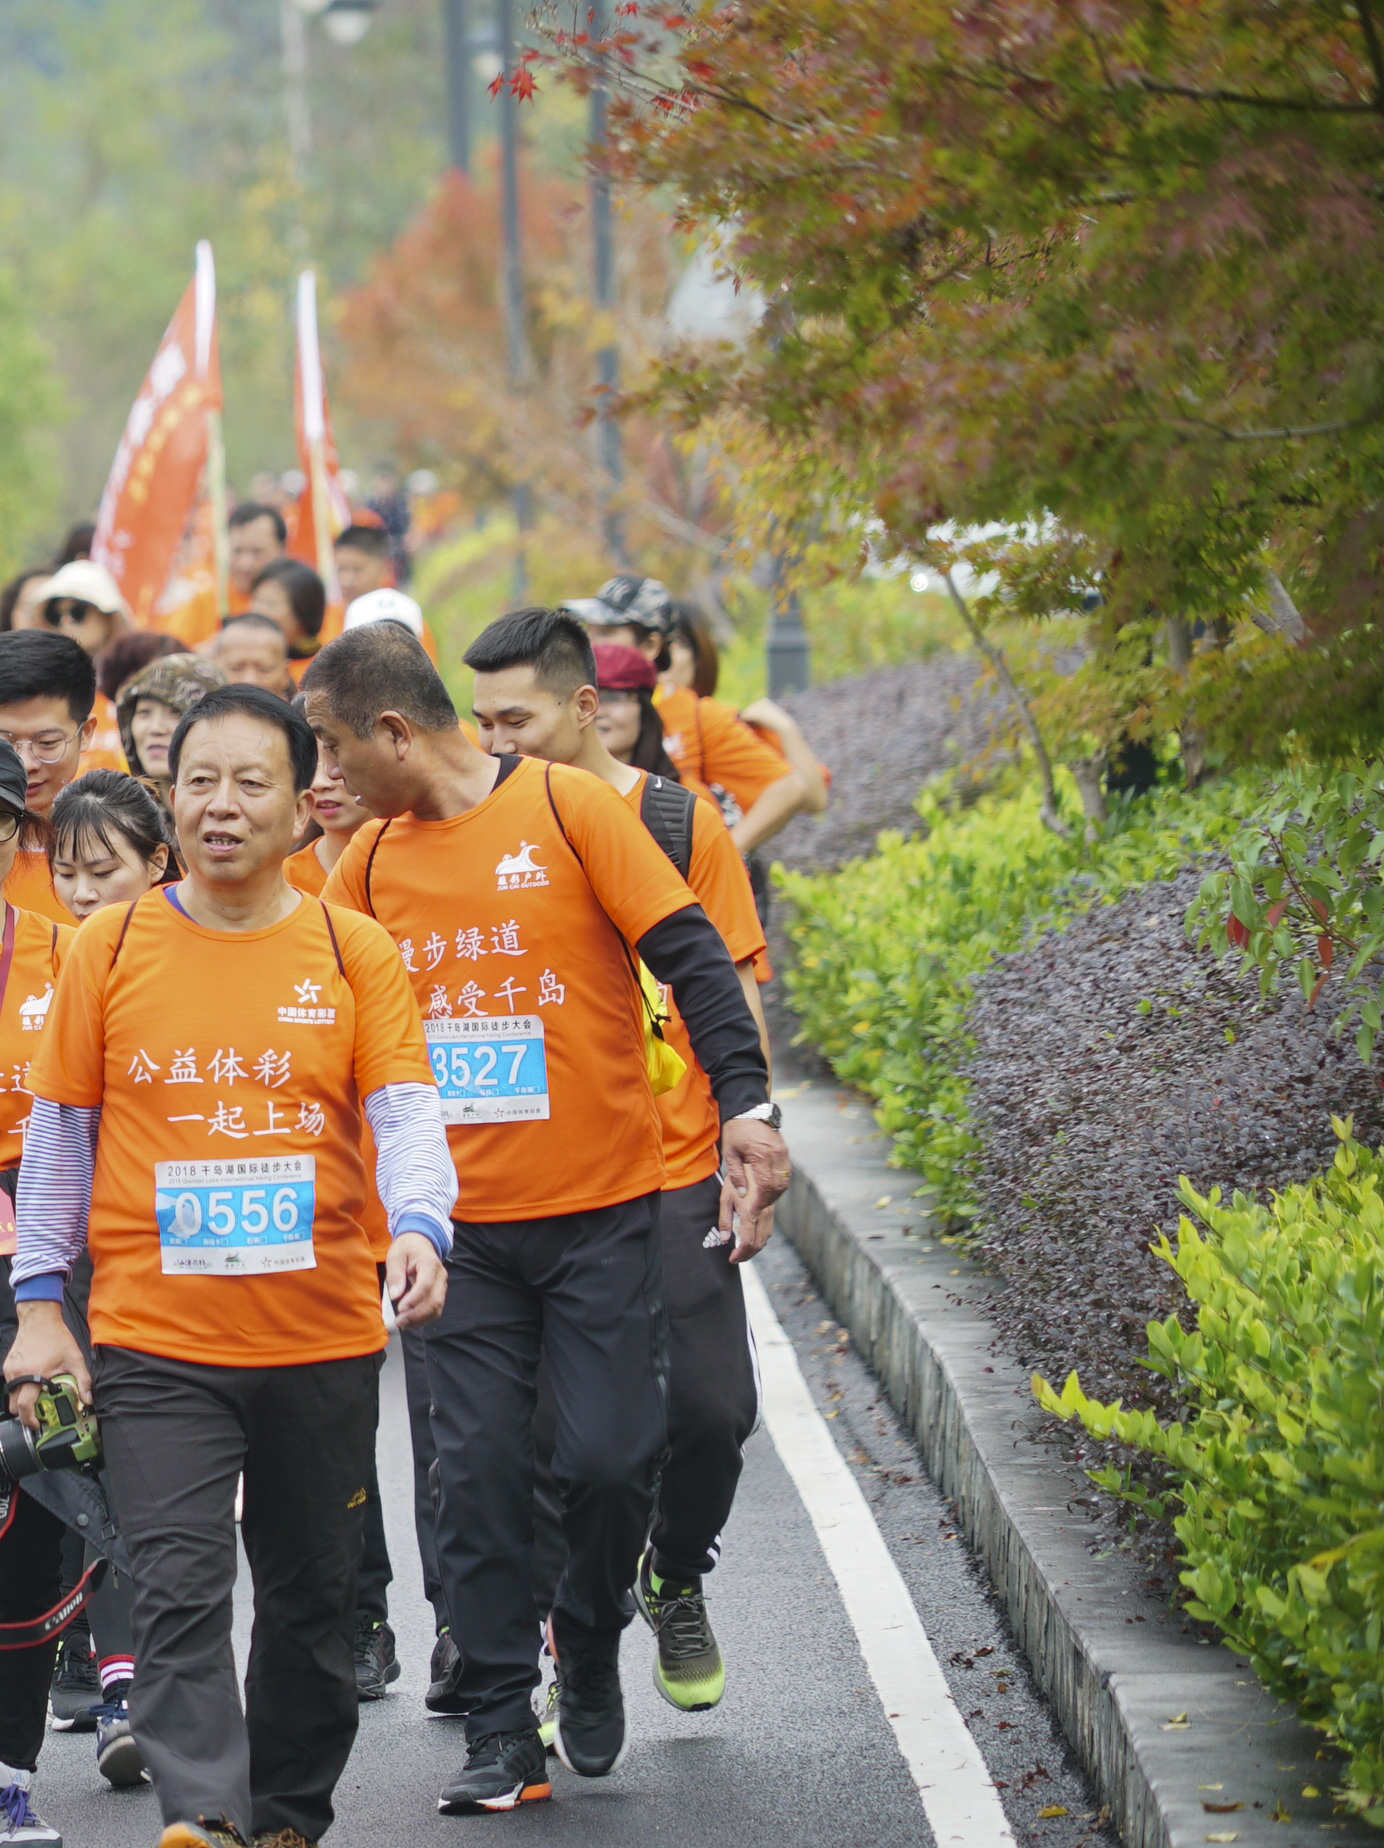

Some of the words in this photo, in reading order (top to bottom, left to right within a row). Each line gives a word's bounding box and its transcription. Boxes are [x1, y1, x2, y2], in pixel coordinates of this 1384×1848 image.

[428, 968, 565, 1019] 感受千岛
[425, 1023, 445, 1033] 2018
[127, 1047, 292, 1089] 公益体彩
[431, 1044, 528, 1088] 3527
[167, 1100, 325, 1140] 一起上场
[168, 1165, 197, 1177] 2018
[175, 1187, 299, 1235] 0556
[44, 1591, 84, 1631] Canon
